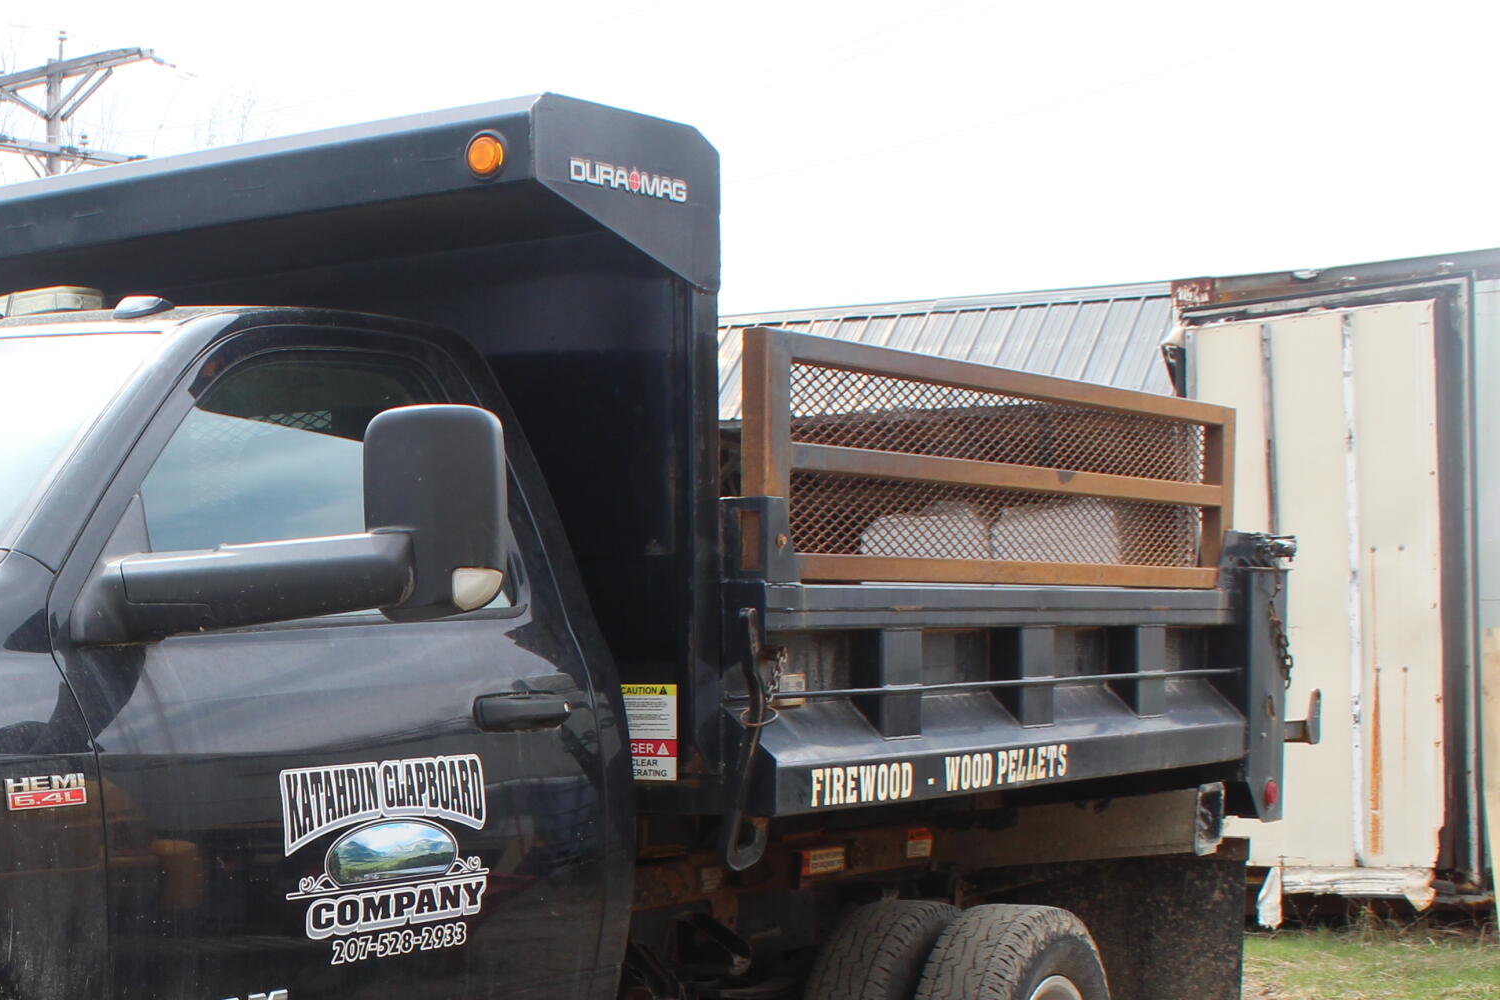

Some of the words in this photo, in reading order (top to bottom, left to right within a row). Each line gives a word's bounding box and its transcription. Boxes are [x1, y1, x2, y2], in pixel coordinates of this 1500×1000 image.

[621, 686, 657, 695] CAUTION
[630, 743, 654, 754] GER
[4, 772, 85, 793] HEMI
[632, 769, 668, 777] ERATING
[811, 761, 913, 807] FIREWOOD
[945, 752, 993, 792] WOOD
[996, 743, 1069, 785] PELLETS
[13, 791, 83, 808] 6.4L
[282, 763, 380, 848] KATAHDIN
[381, 756, 485, 825] CLAPBOARD
[309, 879, 486, 934] COMPANY
[331, 922, 467, 965] 207-528-2933
